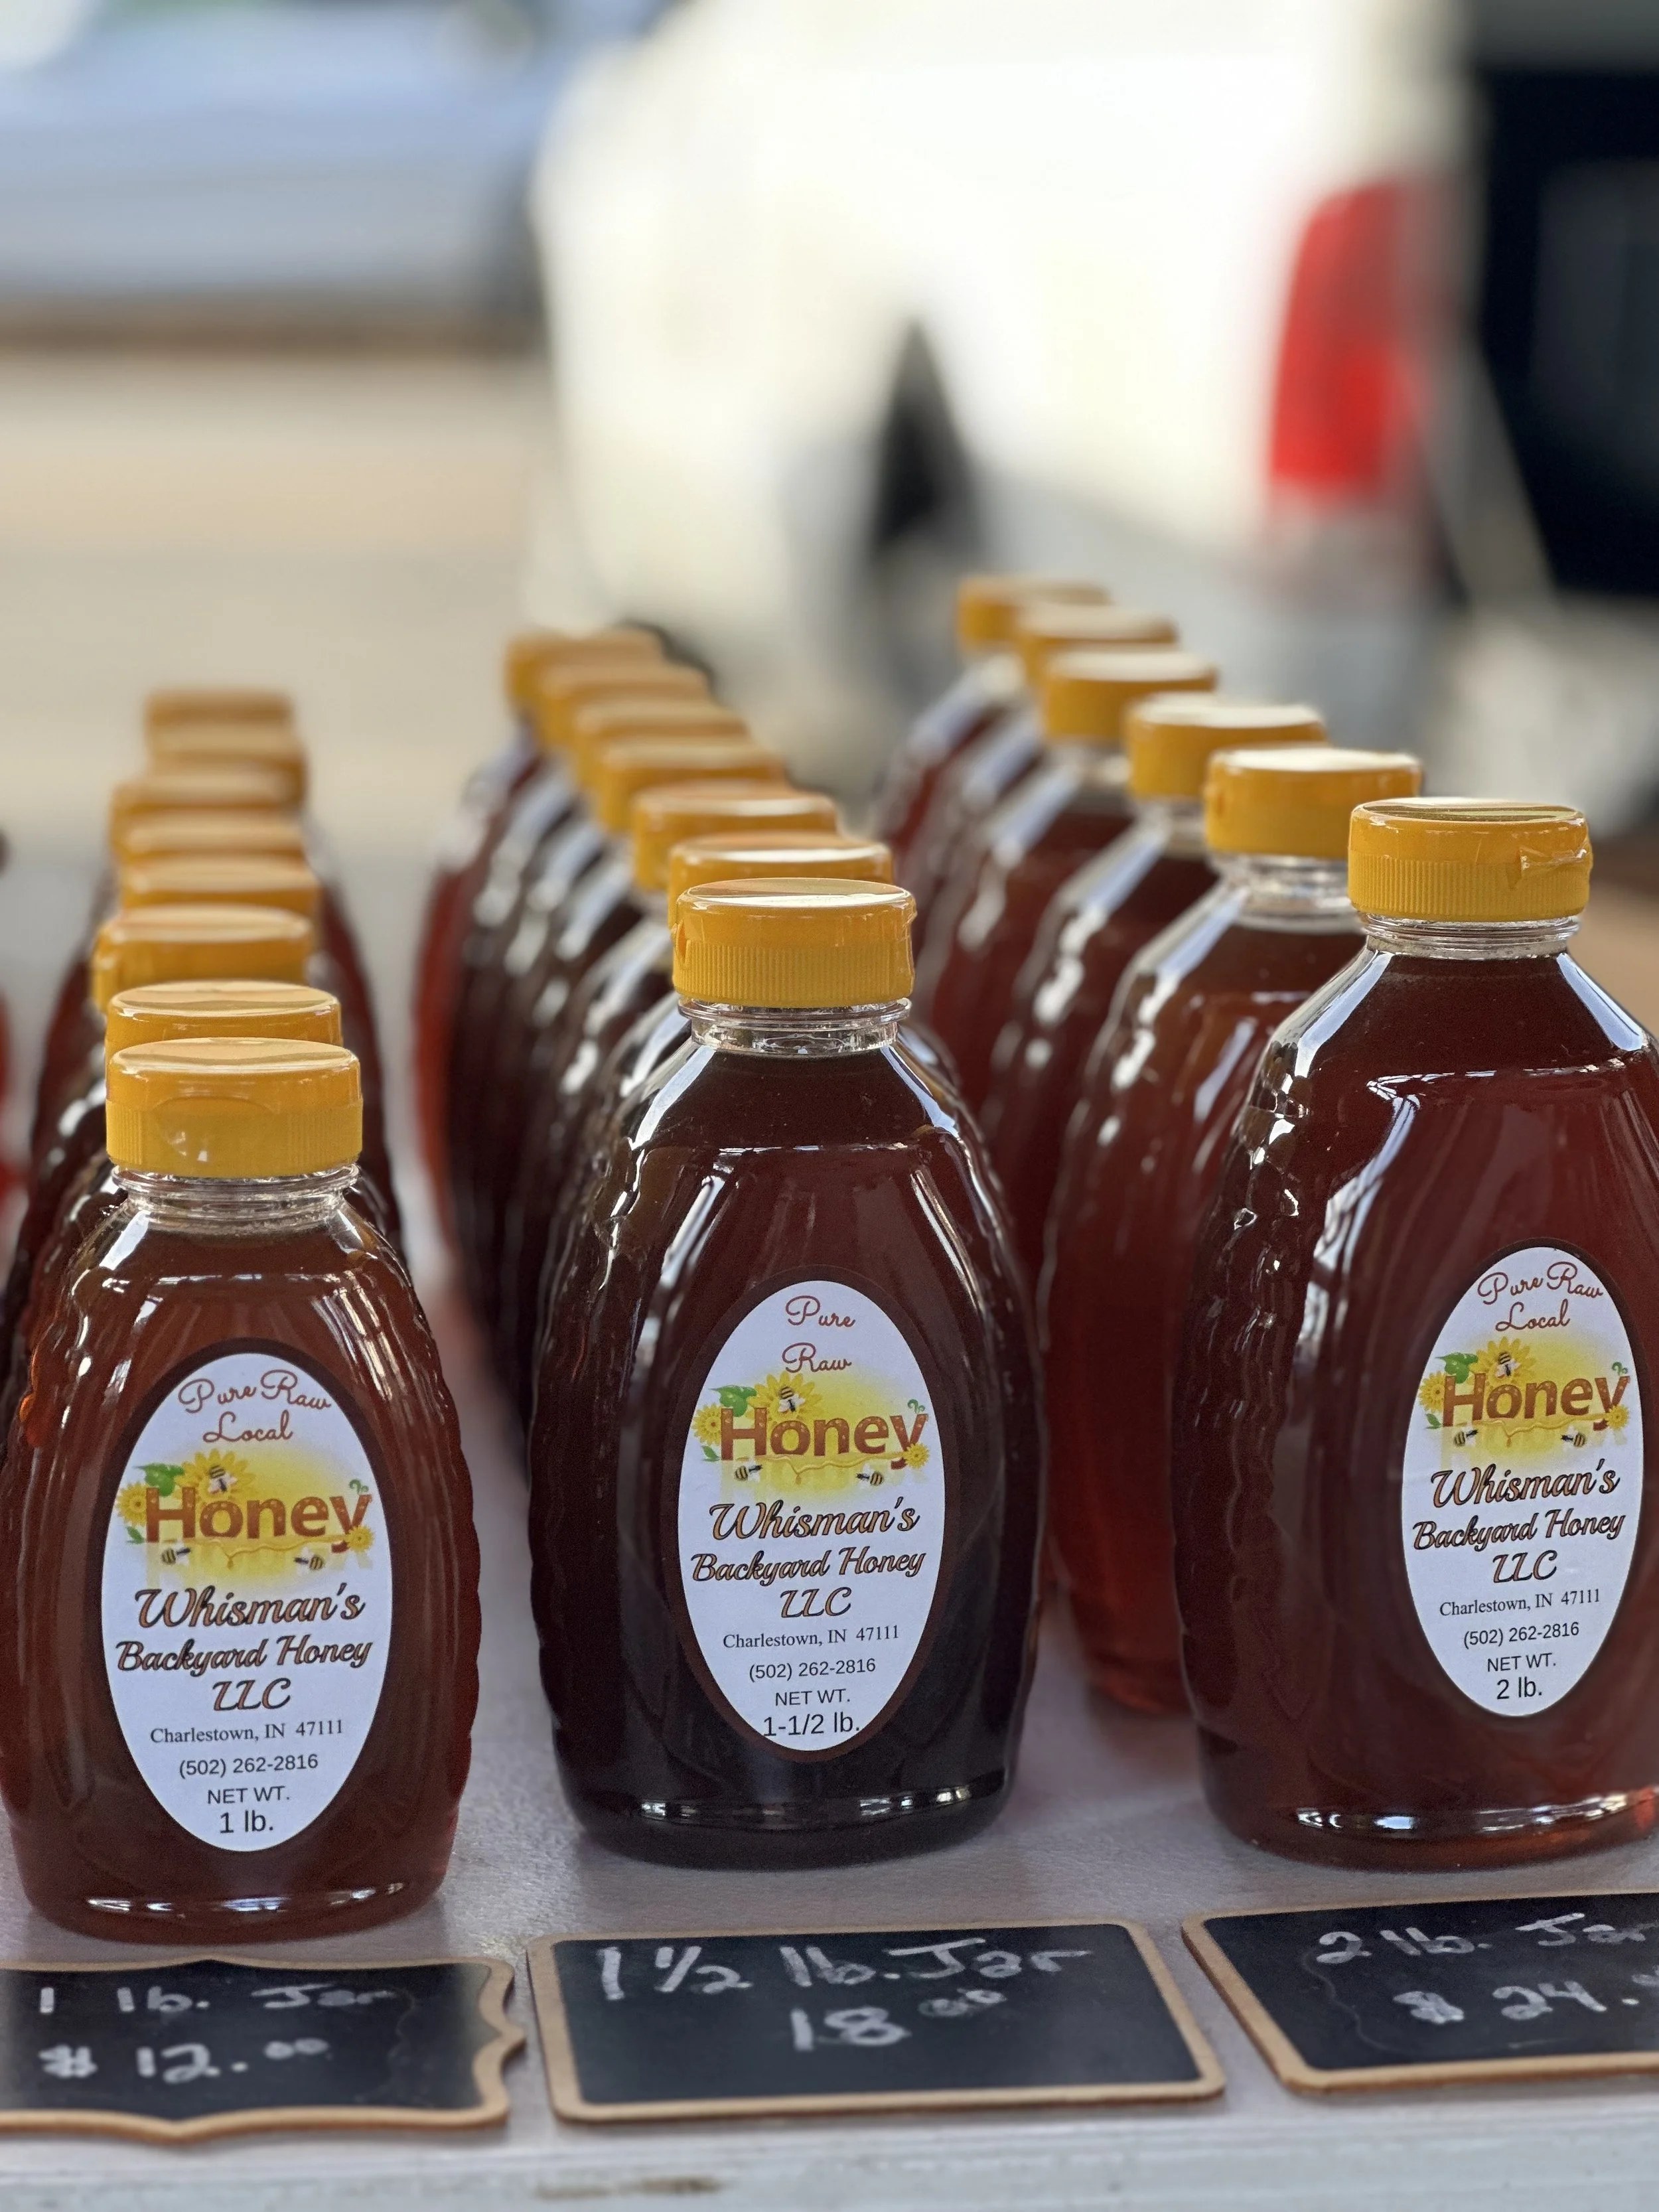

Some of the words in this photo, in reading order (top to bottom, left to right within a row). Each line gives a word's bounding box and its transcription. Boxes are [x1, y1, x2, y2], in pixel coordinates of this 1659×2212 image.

[1477, 1272, 1544, 1305] Pure
[1546, 1261, 1603, 1298] Raw
[785, 1295, 855, 1328] Pure
[1495, 1299, 1570, 1331] Local
[782, 1342, 851, 1373] Raw
[178, 1378, 257, 1414] Pure
[260, 1369, 331, 1410] Raw
[1443, 1373, 1630, 1432] Honey
[202, 1410, 293, 1443] Local
[721, 1408, 928, 1470] Honey
[1431, 1459, 1621, 1508] Whisman's
[145, 1487, 372, 1554] Honey
[709, 1497, 920, 1540] Whisman's
[1412, 1512, 1539, 1552] Backyard
[1545, 1508, 1626, 1540] Honey
[691, 1550, 831, 1586] Backyard
[838, 1546, 926, 1577] Honey
[1492, 1550, 1557, 1583] LLC
[135, 1583, 366, 1628] Whisman's
[780, 1587, 851, 1618] LLC
[1439, 1599, 1531, 1616] Charlestown,
[1536, 1593, 1553, 1608] IN
[1561, 1589, 1600, 1605] 47111
[723, 1633, 823, 1648] Charlestown,
[828, 1629, 847, 1643] IN
[855, 1625, 899, 1641] 47111
[1463, 1629, 1504, 1649] (502)
[1509, 1622, 1579, 1642] 262-2816
[115, 1639, 268, 1677] Backyard
[276, 1634, 373, 1668] Honey
[749, 1662, 793, 1682] (502)
[798, 1659, 876, 1676] 262-2816
[1487, 1657, 1521, 1672] NET
[1526, 1653, 1556, 1668] WT.
[212, 1678, 291, 1711] LLC
[775, 1691, 812, 1706] NET
[818, 1688, 850, 1704] WT.
[1496, 1680, 1510, 1700] 2
[1518, 1676, 1542, 1698] lb.
[150, 1728, 259, 1743] Charlestown,
[265, 1724, 285, 1738] IN
[295, 1720, 343, 1736] 47111
[763, 1714, 824, 1736] 1-1/2
[834, 1712, 860, 1732] lb.
[179, 1759, 226, 1779] (502)
[233, 1754, 319, 1774] 262-2816
[207, 1789, 248, 1805] NET
[253, 1786, 290, 1802] WT.
[219, 1812, 234, 1833] 1
[245, 1810, 273, 1832] lb.
[598, 1947, 625, 2001] 1
[883, 1937, 1094, 1980] Jar
[39, 1986, 55, 2014] 1
